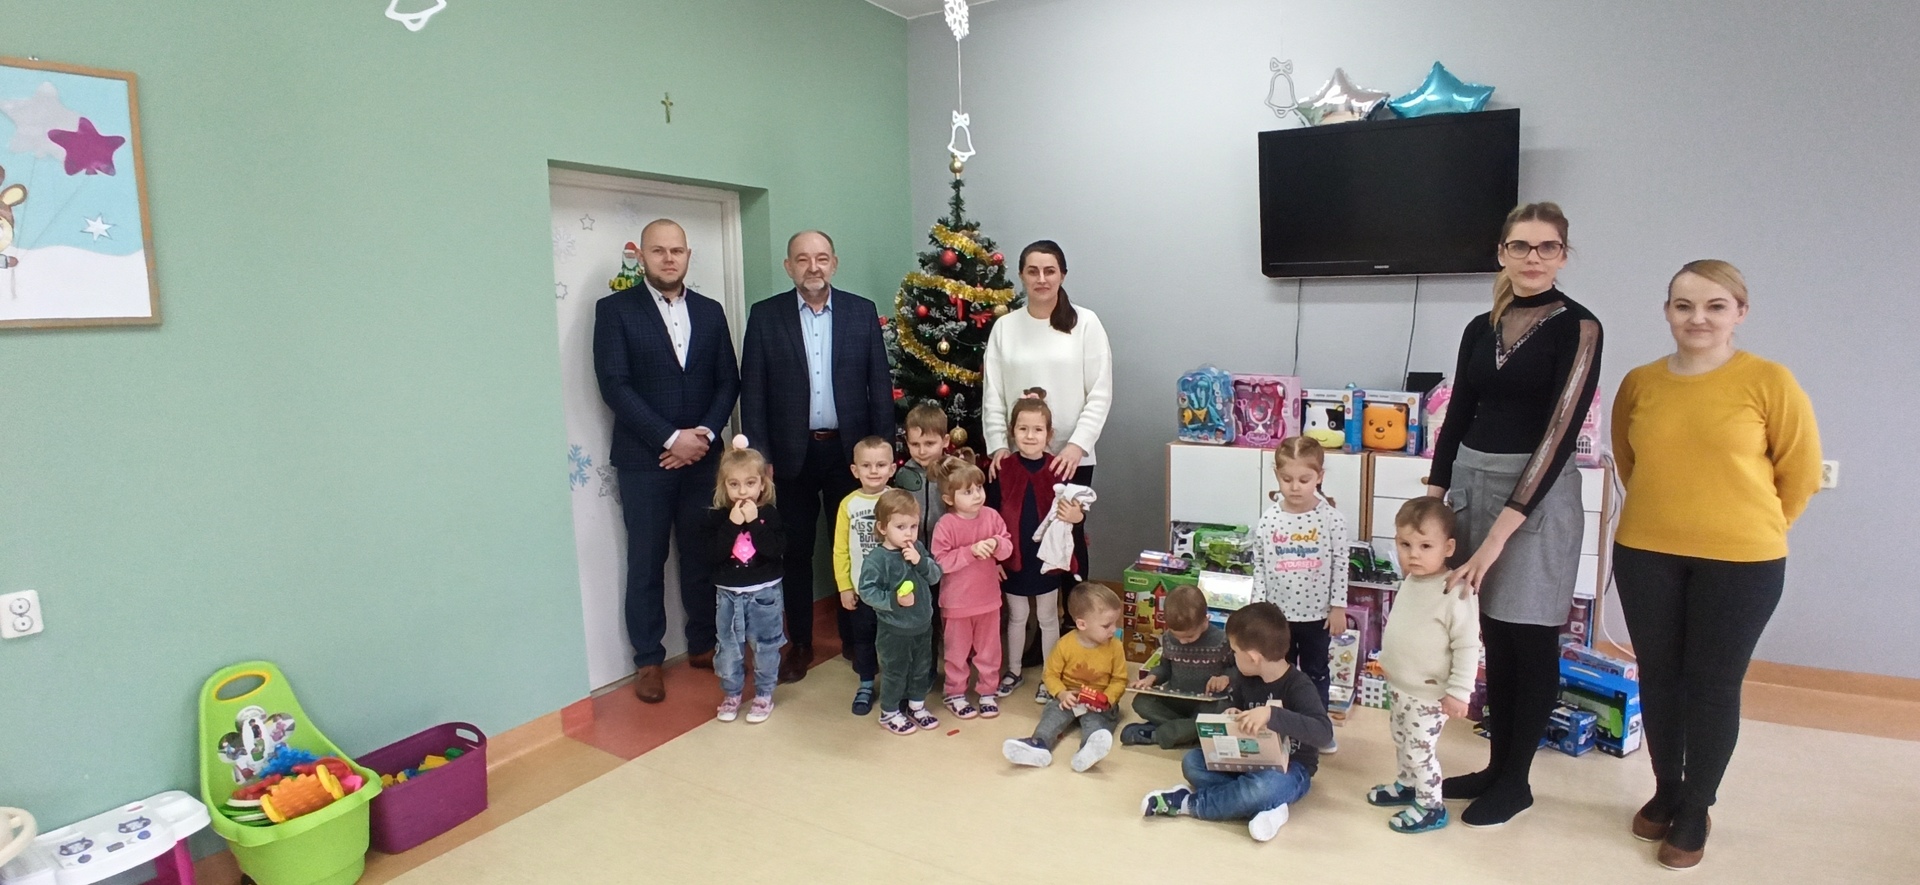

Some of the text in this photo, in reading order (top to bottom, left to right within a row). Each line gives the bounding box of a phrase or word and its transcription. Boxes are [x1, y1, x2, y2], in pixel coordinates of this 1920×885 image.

[855, 509, 871, 517] SHIP
[1272, 528, 1318, 543] be cool
[1284, 560, 1318, 568] YOURSELF
